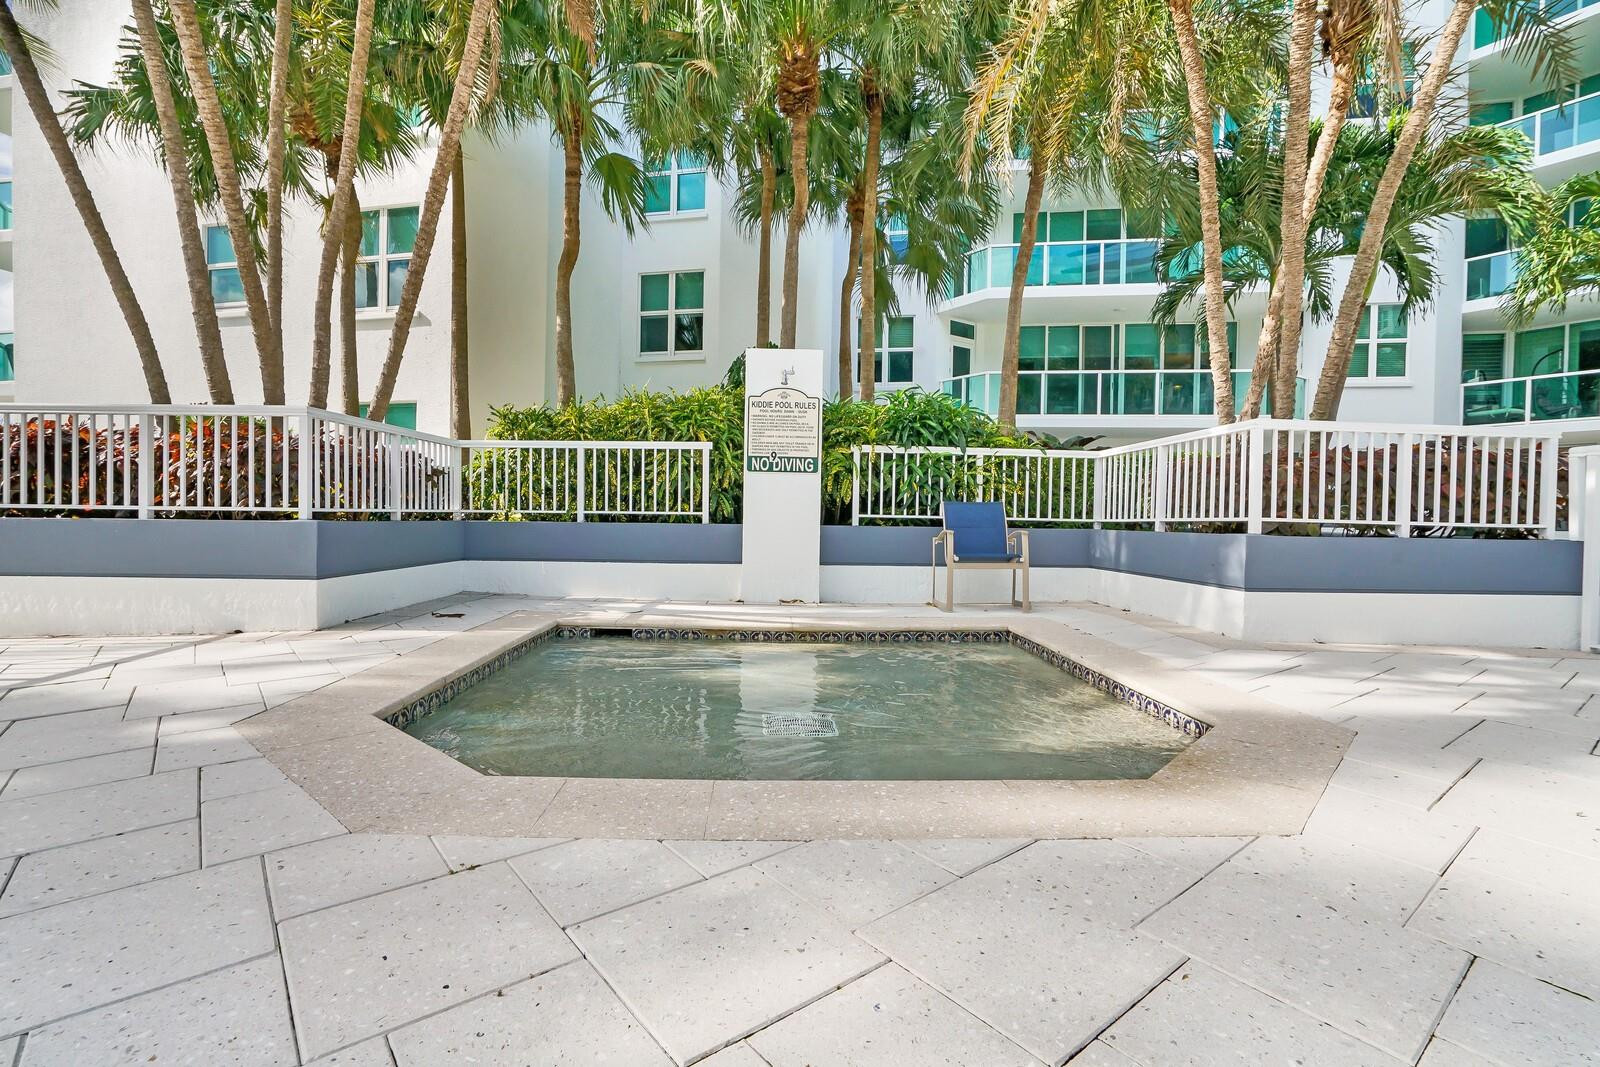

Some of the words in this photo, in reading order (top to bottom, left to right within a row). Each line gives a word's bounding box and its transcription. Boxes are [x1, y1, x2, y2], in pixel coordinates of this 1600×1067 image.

[751, 401, 773, 409] KIDDIE
[775, 401, 793, 409] POOL
[794, 402, 817, 410] RULES
[771, 451, 777, 461] 9
[751, 457, 769, 471] NO
[772, 458, 814, 472] DIVING
